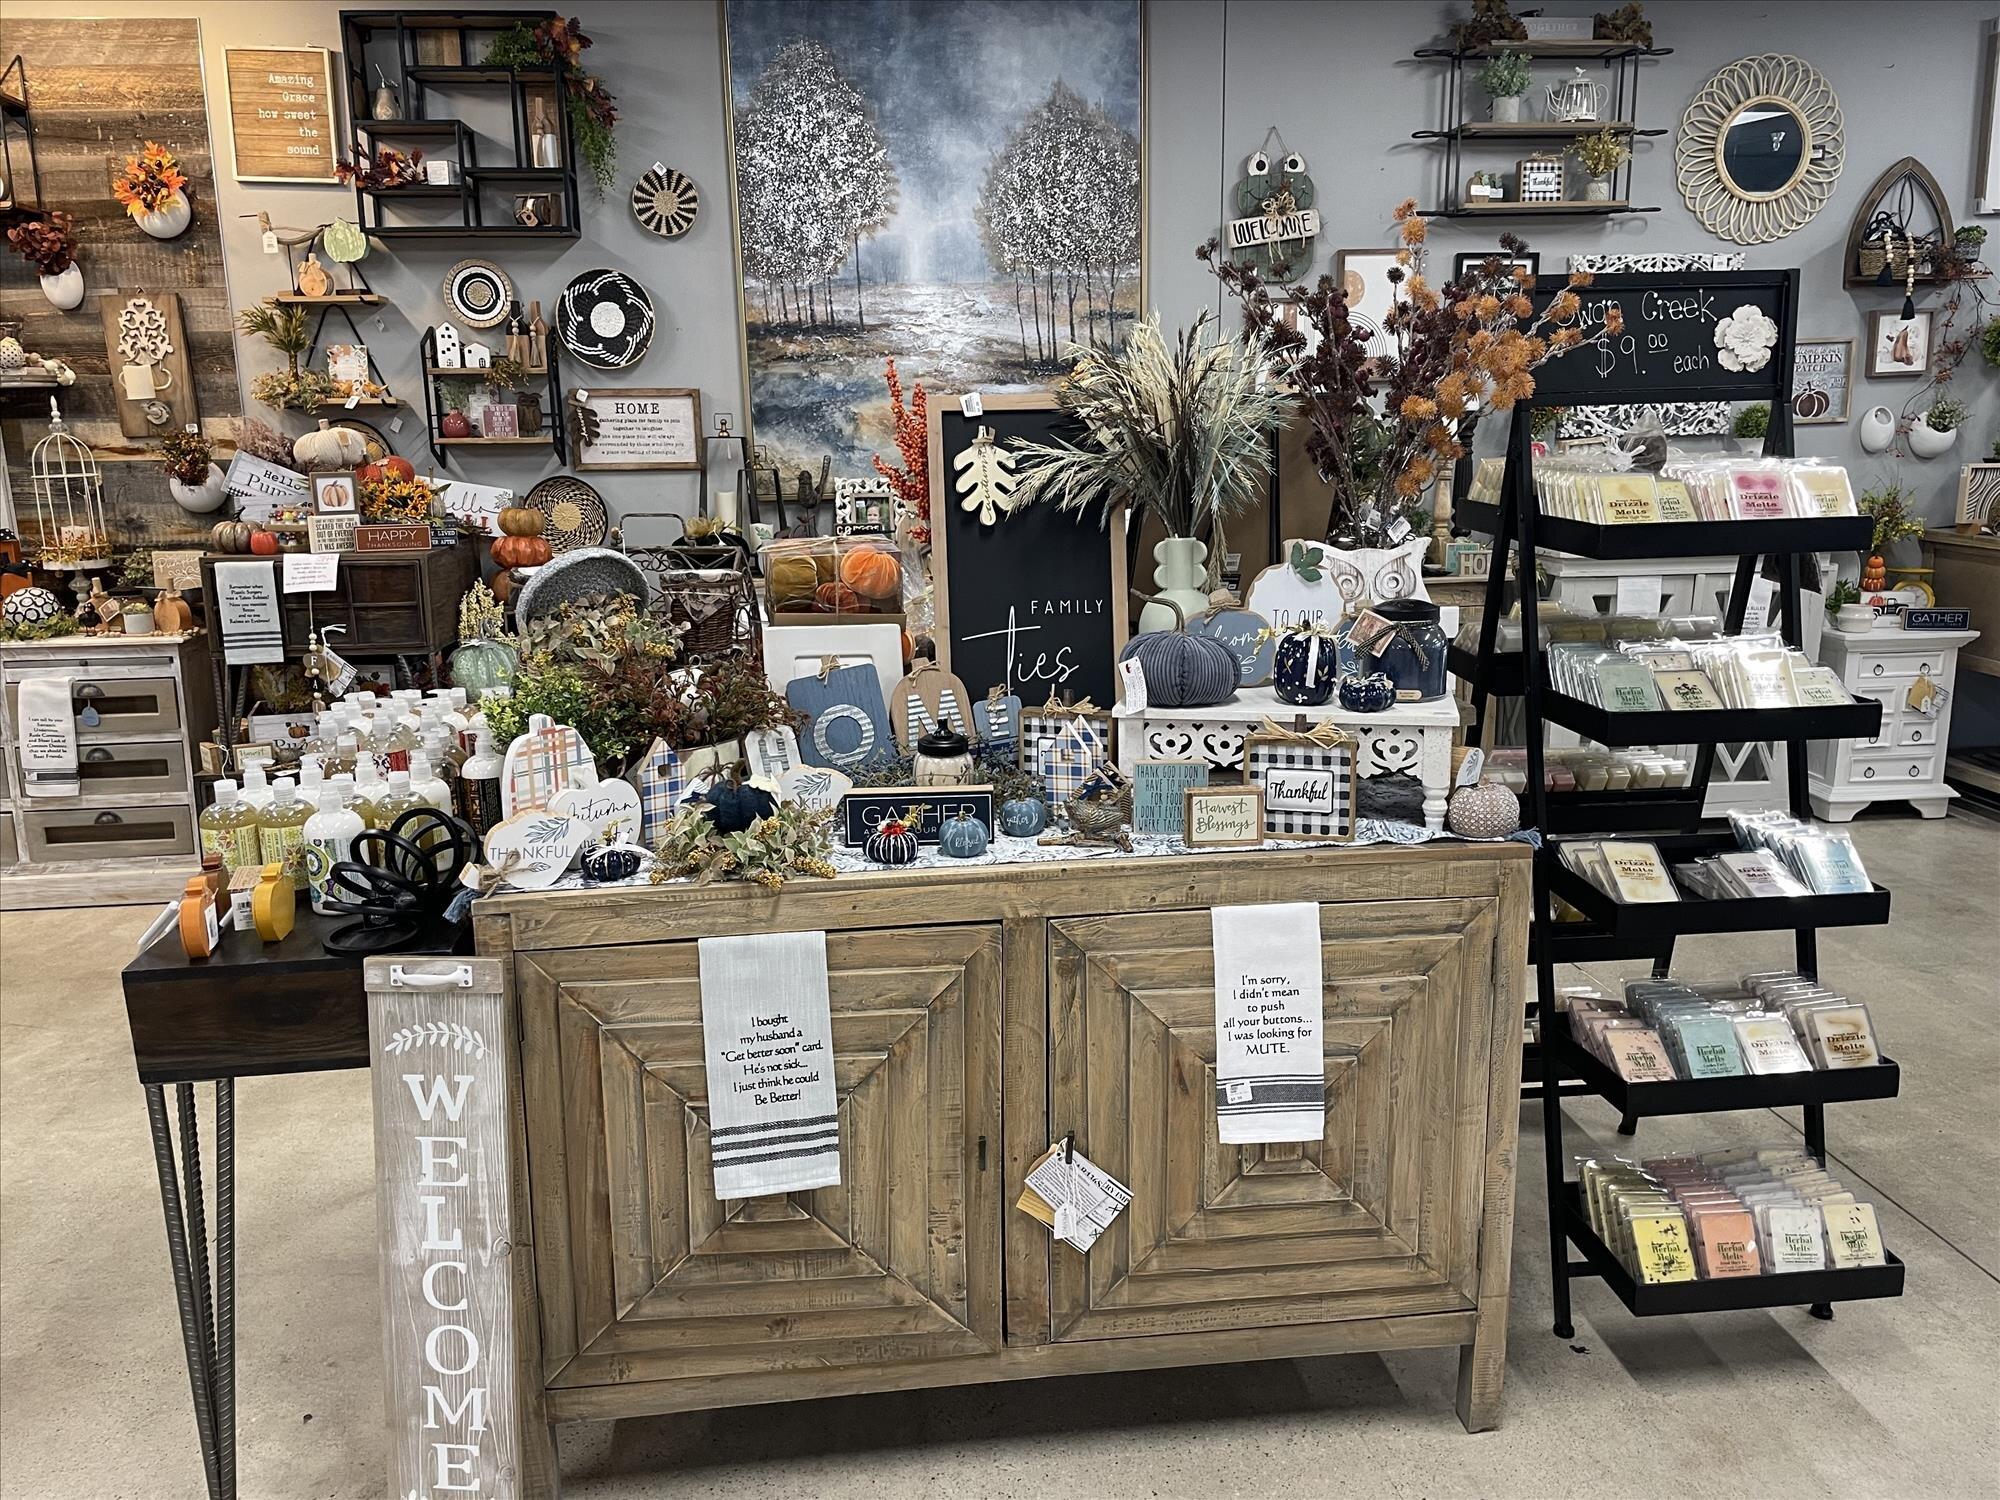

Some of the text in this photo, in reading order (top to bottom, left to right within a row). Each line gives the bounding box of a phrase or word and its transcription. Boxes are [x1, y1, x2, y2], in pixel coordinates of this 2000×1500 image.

[268, 73, 314, 88] Amazing
[282, 91, 315, 102] Grace
[258, 108, 317, 120] how sweet
[299, 127, 318, 137] the
[287, 145, 320, 155] sound
[1642, 289, 1718, 324] Creek
[1673, 345, 1710, 374] each
[1794, 353, 1843, 364] UMPKIN
[1796, 364, 1826, 372] PATCH
[615, 402, 660, 414] HOME
[263, 469, 302, 491] Hello
[368, 529, 417, 541] HAPPY
[367, 541, 423, 549] THANKSGIVING
[1031, 600, 1104, 615] FAMILY
[1273, 609, 1290, 630] TO
[1912, 613, 1963, 623] GATHER
[1137, 765, 1160, 779] THANK
[1163, 765, 1176, 779] GOD
[1145, 779, 1163, 792] HAVE
[1166, 779, 1175, 792] TO
[1270, 780, 1328, 803] Thankful
[1151, 792, 1184, 805] FOR FOOD
[567, 798, 639, 822] Autumn
[1165, 805, 1182, 819] EVEN
[1194, 798, 1250, 815] Harvest
[862, 803, 976, 827] GATHER
[1138, 819, 1184, 832] WHERE TACOS
[1195, 816, 1255, 838] Blessings
[1242, 975, 1290, 986] I'm sorry,
[1233, 987, 1300, 1000] I didn't mean
[1247, 1000, 1285, 1014] to push
[751, 1013, 789, 1028] I bought
[1223, 1014, 1313, 1029] all your buttons...
[739, 1026, 803, 1045] my husband a
[1228, 1026, 1313, 1042] I was looking for
[1826, 1033, 1867, 1043] Drizzle
[720, 1050, 746, 1063] "Get
[746, 1048, 774, 1060] better
[774, 1041, 800, 1056] soon"
[1245, 1042, 1291, 1057] MUTE.
[1697, 1046, 1726, 1057] Herbal
[1833, 1043, 1865, 1052] Melts
[1702, 1055, 1725, 1063] Melts
[743, 1062, 766, 1076] He's
[766, 1062, 783, 1073] not
[733, 1071, 820, 1094] I just think he could
[754, 1088, 801, 1106] Be Better!
[1785, 1236, 1813, 1244] Herbal
[1840, 1232, 1868, 1241] Herbal
[1652, 1245, 1680, 1253] Herbal
[1717, 1244, 1745, 1252] Herbal
[1789, 1244, 1811, 1252] Melts
[1846, 1241, 1868, 1249] Melts
[1657, 1253, 1678, 1261] Melts
[1722, 1252, 1743, 1260] Melts
[402, 1073, 487, 1492] WELCOME
